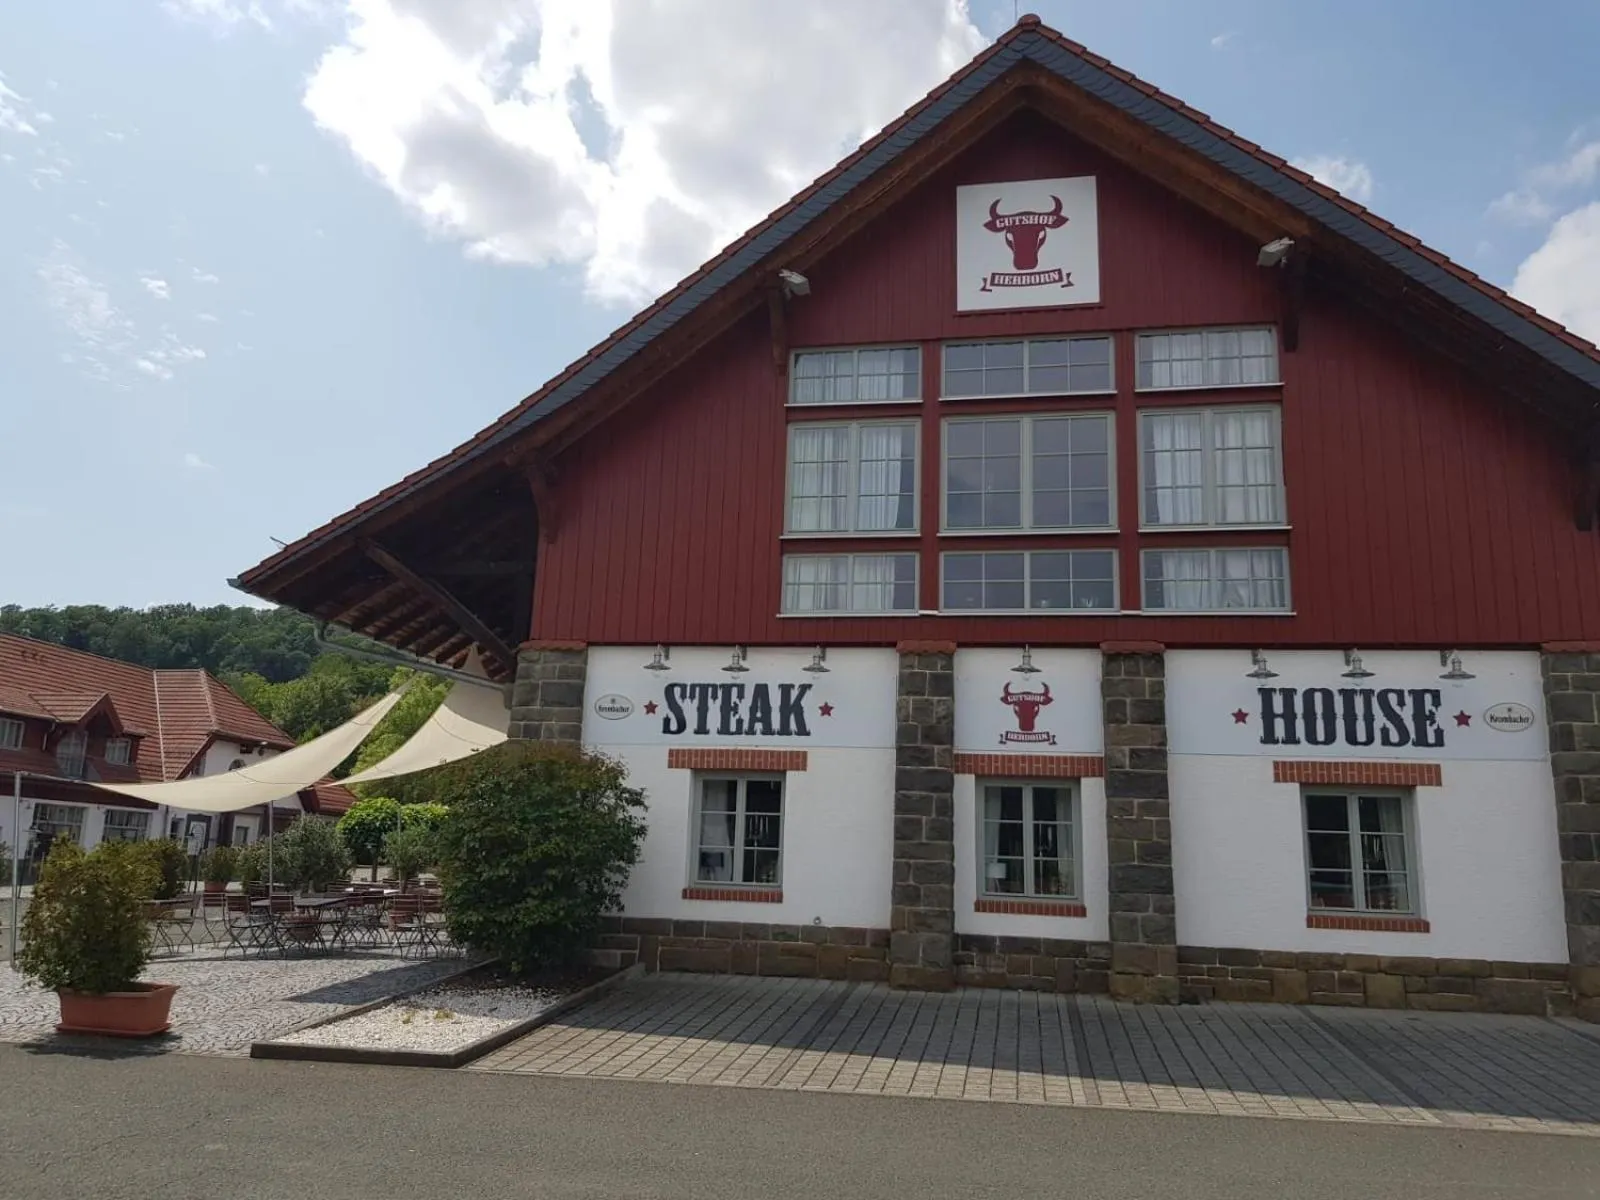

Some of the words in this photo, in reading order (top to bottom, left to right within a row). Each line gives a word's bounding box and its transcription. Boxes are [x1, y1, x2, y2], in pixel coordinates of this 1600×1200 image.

[996, 214, 1057, 228] GUTSHOF
[994, 271, 1060, 286] HERBORN
[662, 683, 813, 736] STEAK
[1257, 687, 1445, 747] HOUSE
[1490, 713, 1530, 723] Krombacher
